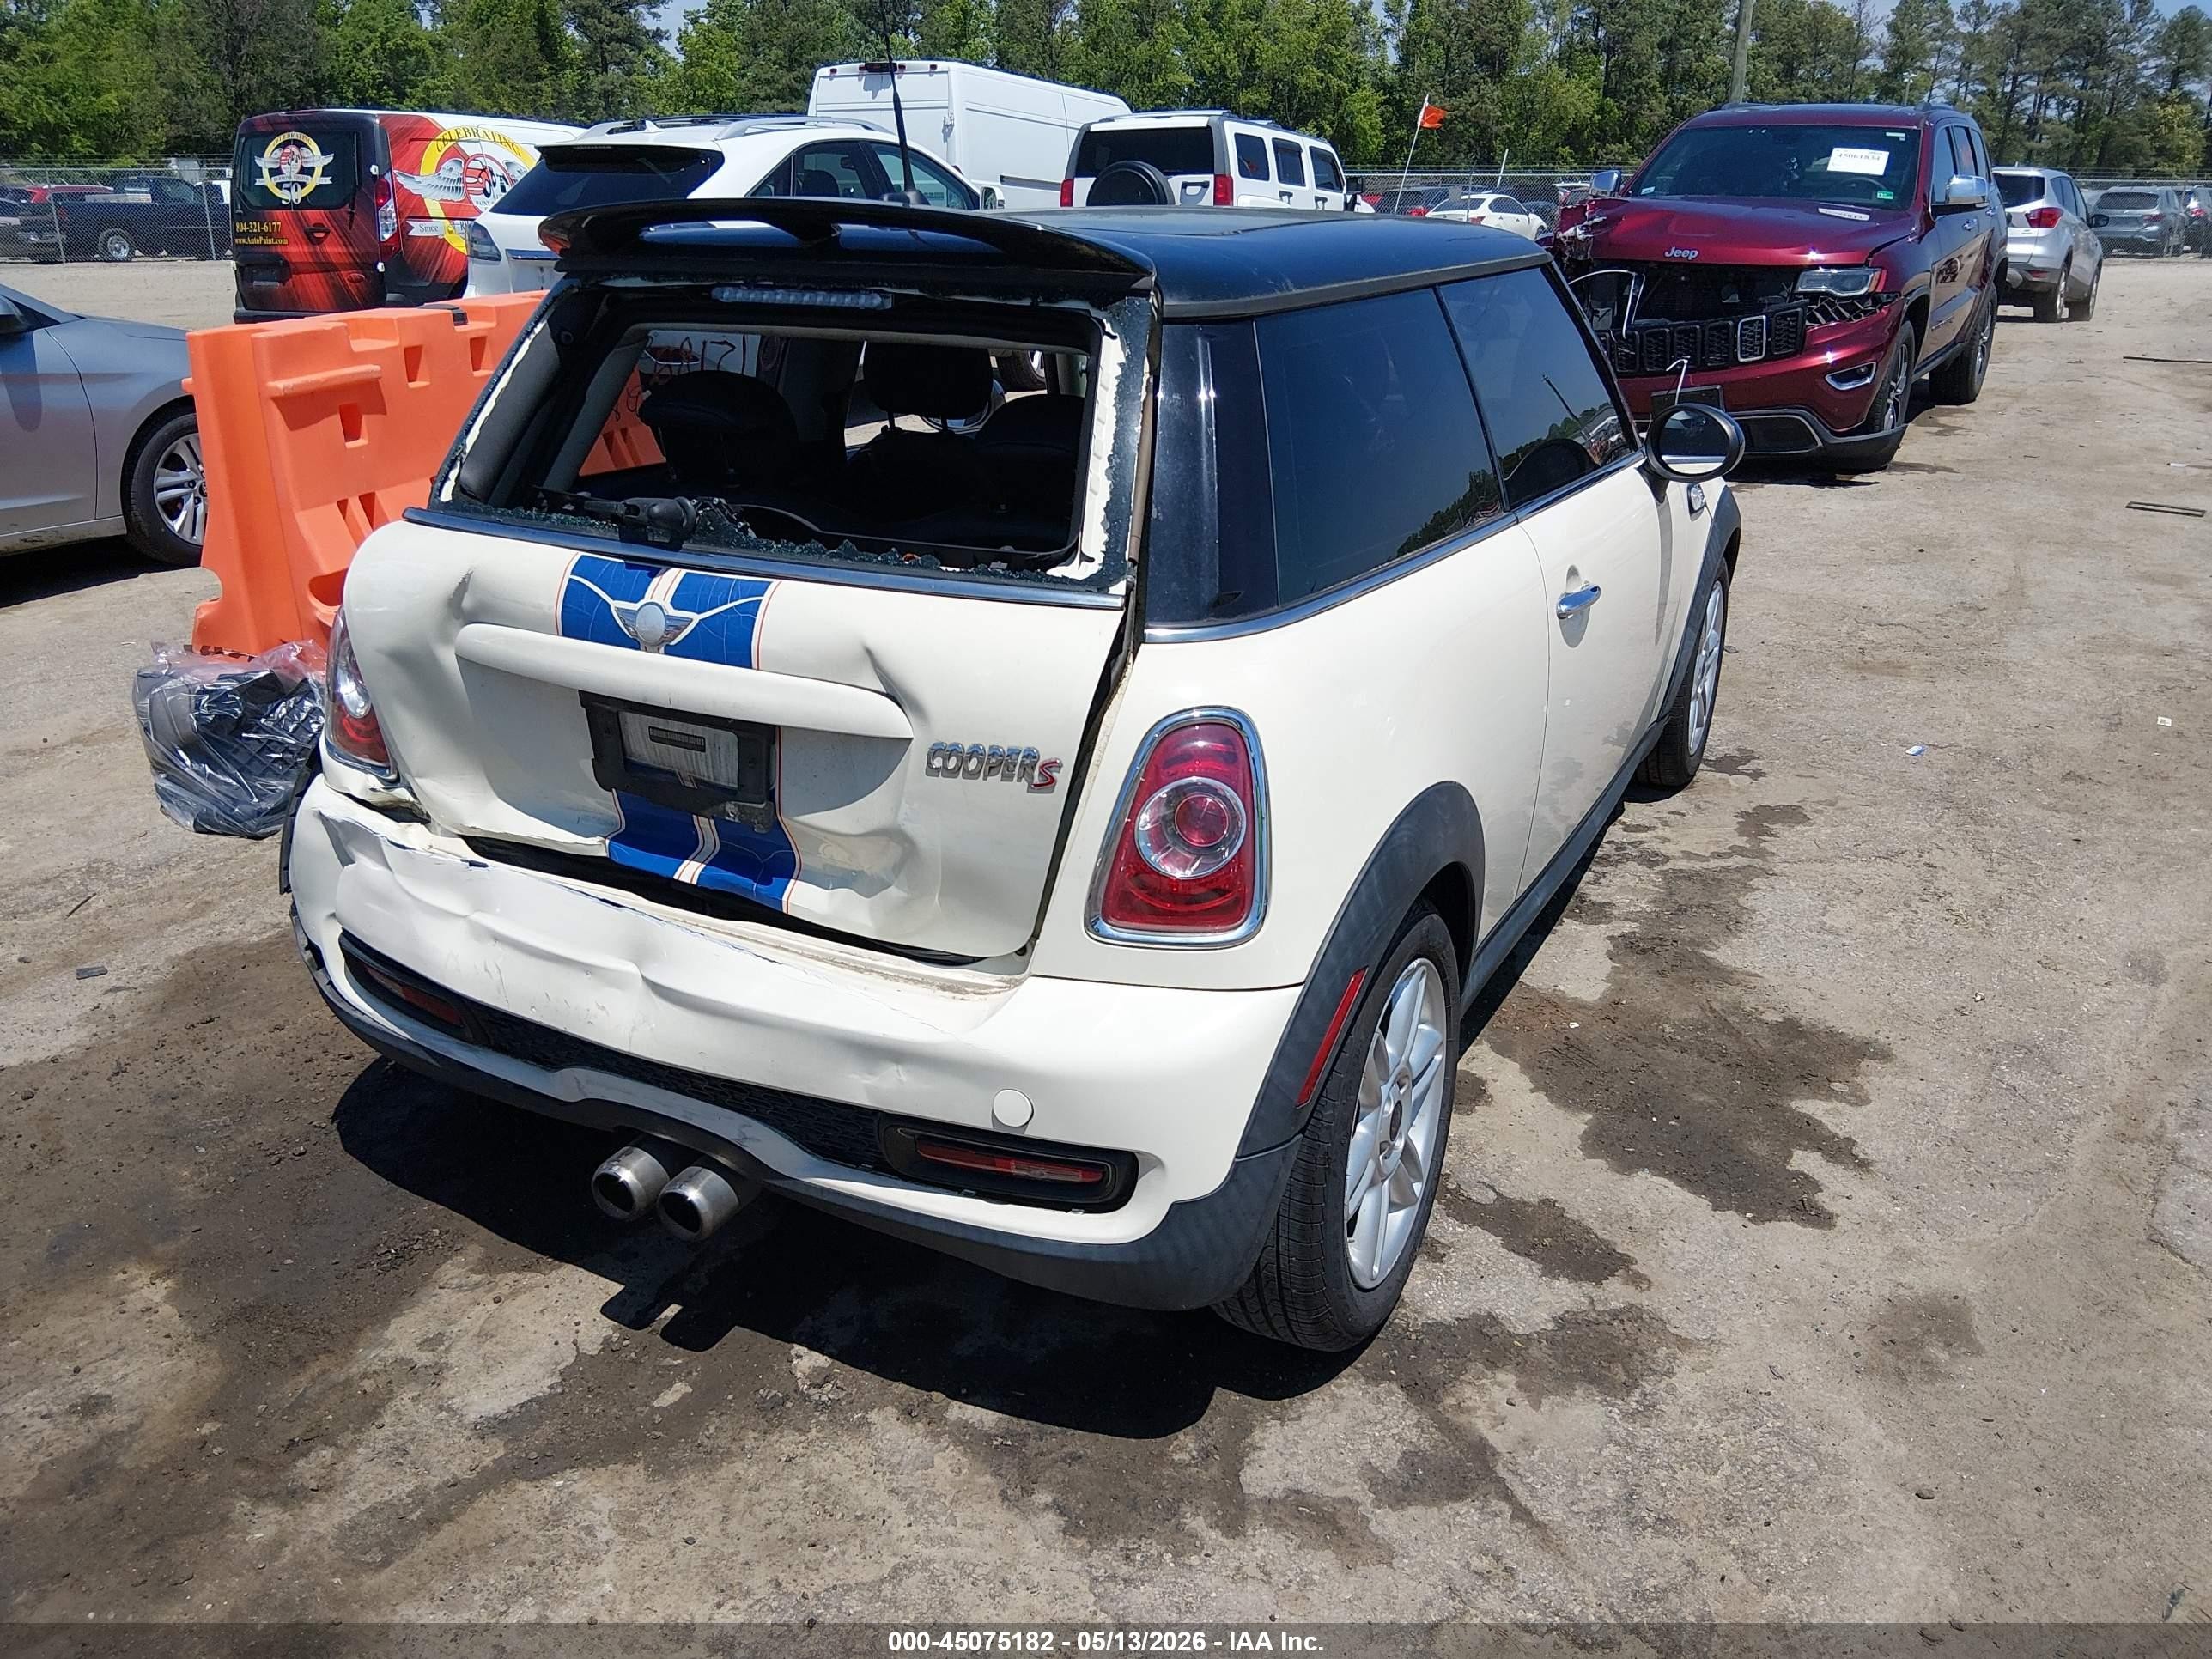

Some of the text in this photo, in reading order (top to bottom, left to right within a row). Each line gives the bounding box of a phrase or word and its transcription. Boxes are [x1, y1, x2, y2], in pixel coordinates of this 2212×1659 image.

[435, 127, 522, 156] CELEBRATING
[281, 183, 302, 205] 50
[235, 222, 282, 233] 804-321-6177
[419, 223, 439, 233] Since
[234, 236, 289, 245] www.AutoPaint.com
[1664, 246, 1698, 260] Jeep
[927, 741, 1064, 791] COOPER S
